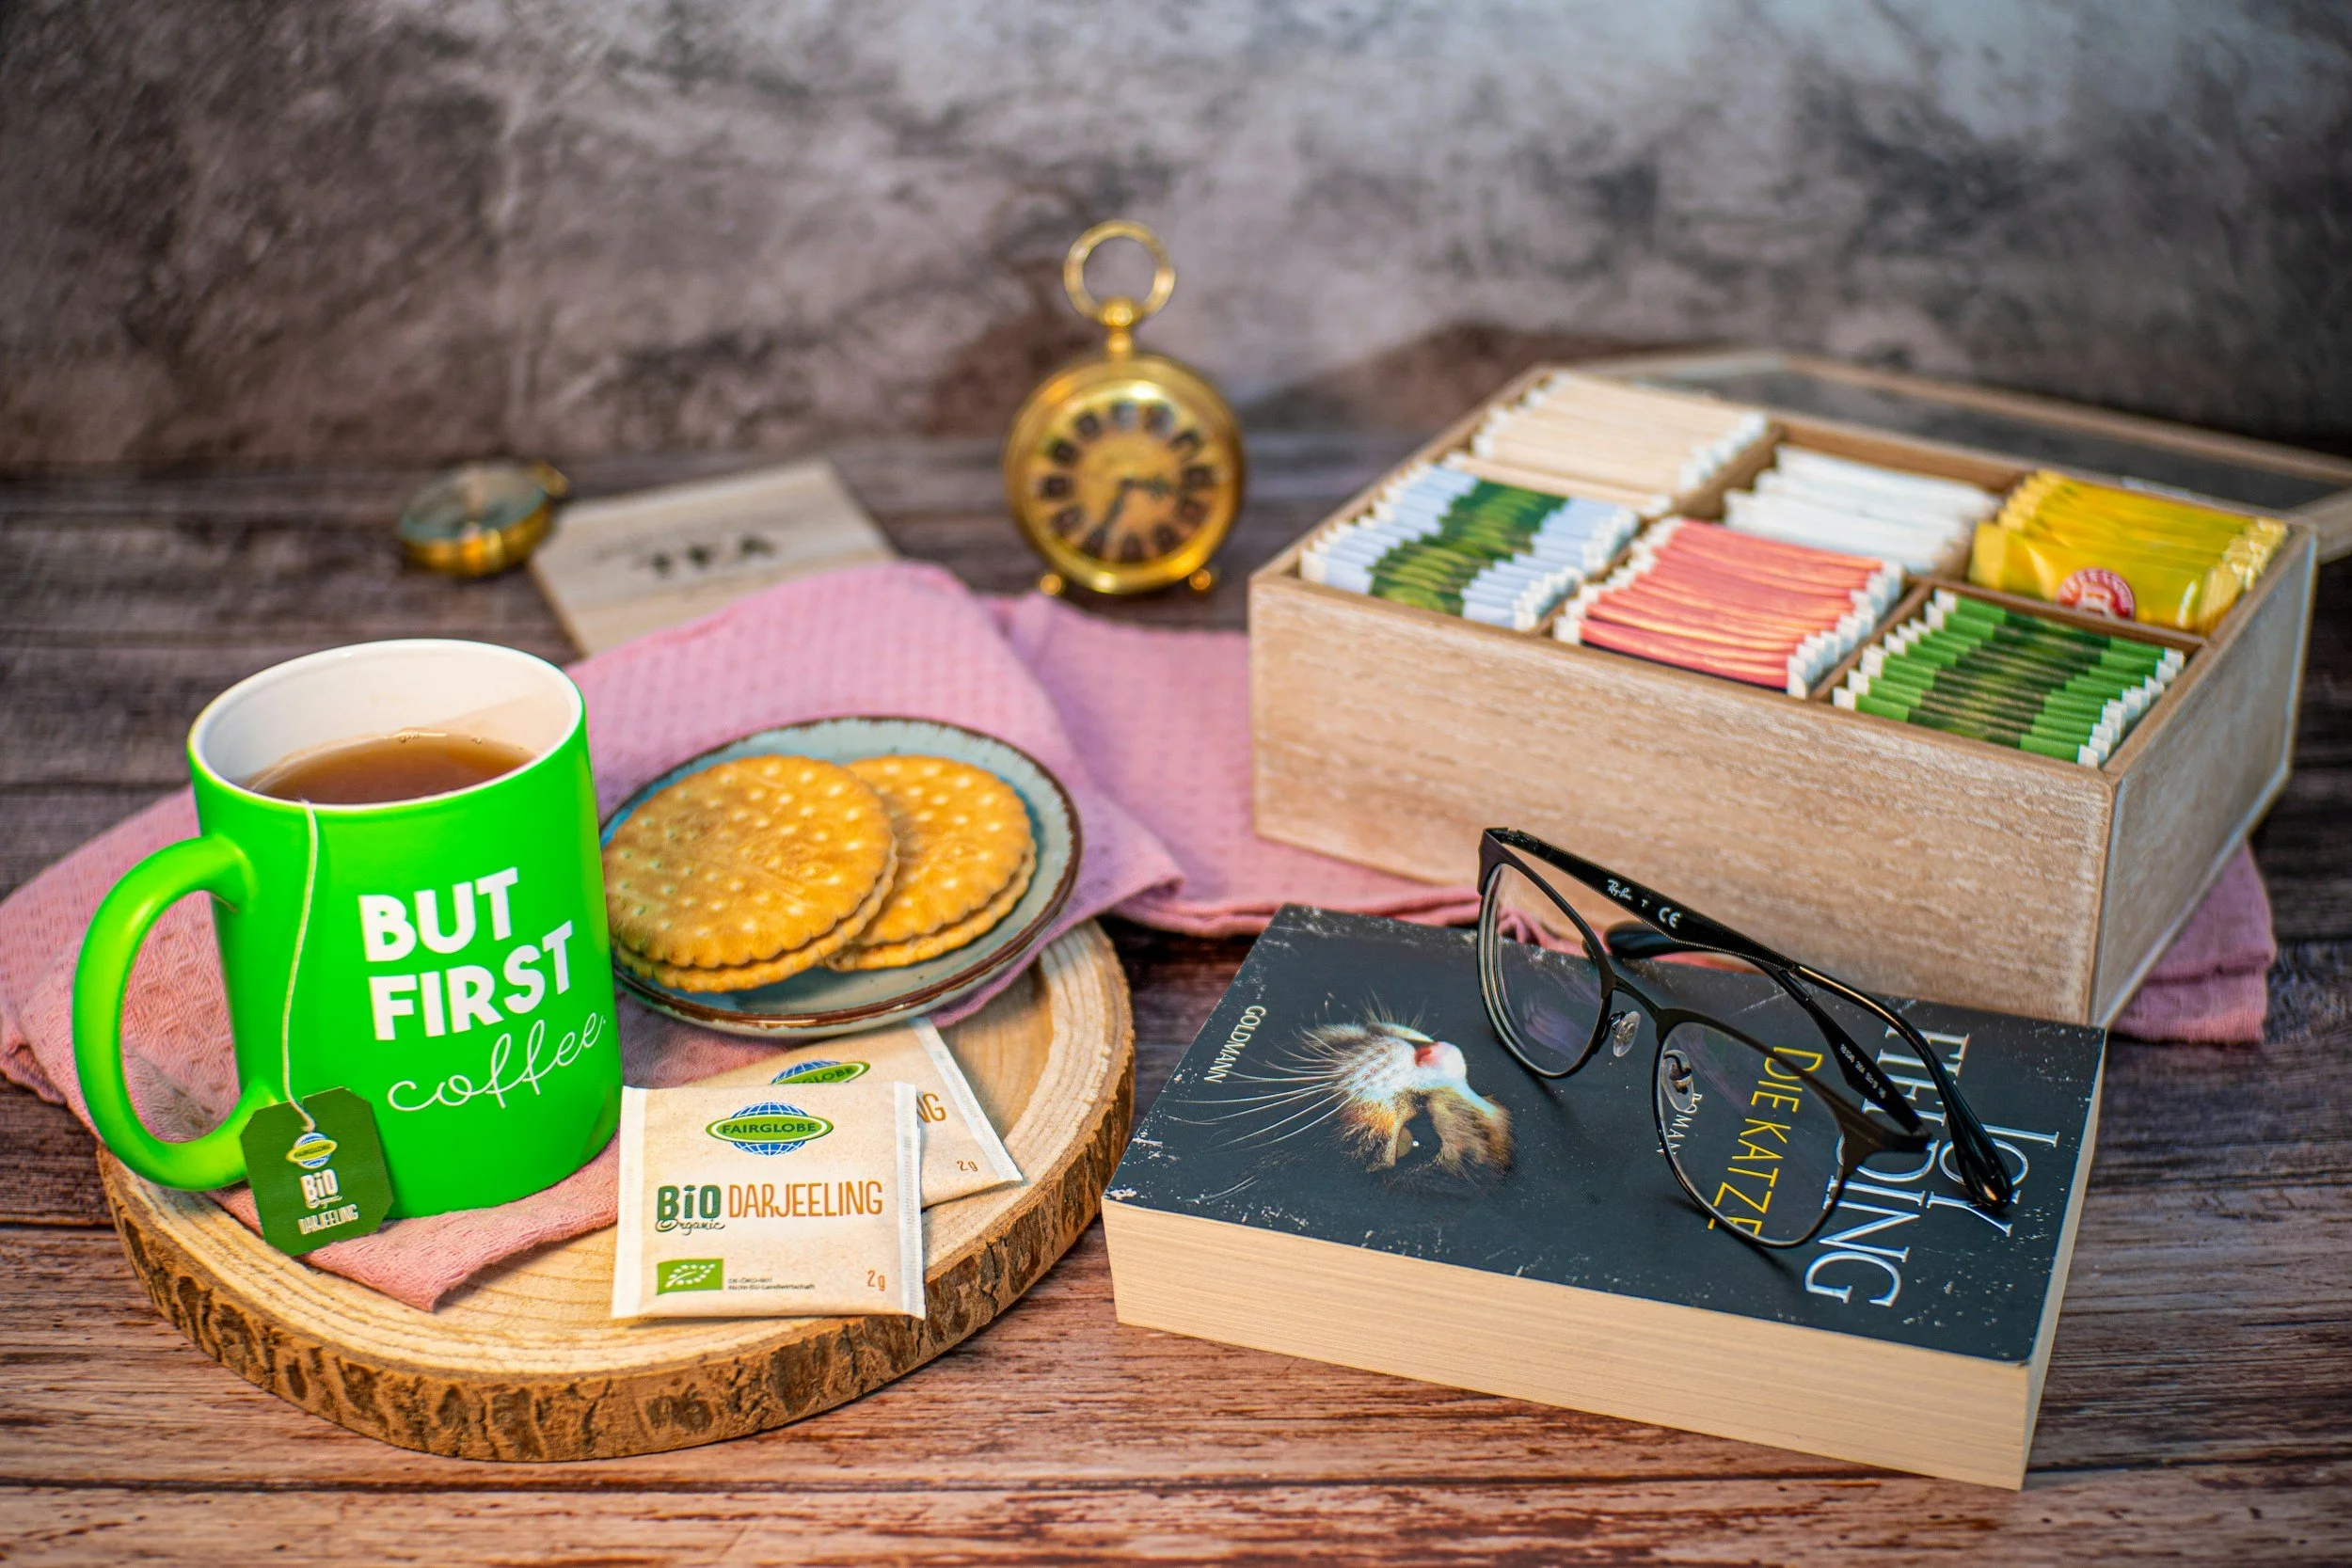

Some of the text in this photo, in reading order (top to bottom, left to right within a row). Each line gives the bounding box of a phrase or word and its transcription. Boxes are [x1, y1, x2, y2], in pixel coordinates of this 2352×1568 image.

[358, 866, 518, 962] BUT
[368, 920, 573, 1041] FIRST
[1203, 1006, 1266, 1083] GOLDMANN
[1750, 1046, 1824, 1113] DIE
[722, 1122, 817, 1134] FAIRGLOBE
[957, 1160, 978, 1173] 2g
[729, 1180, 883, 1219] DARJEELING
[655, 1217, 725, 1236] Organic
[866, 1270, 885, 1291] 2g
